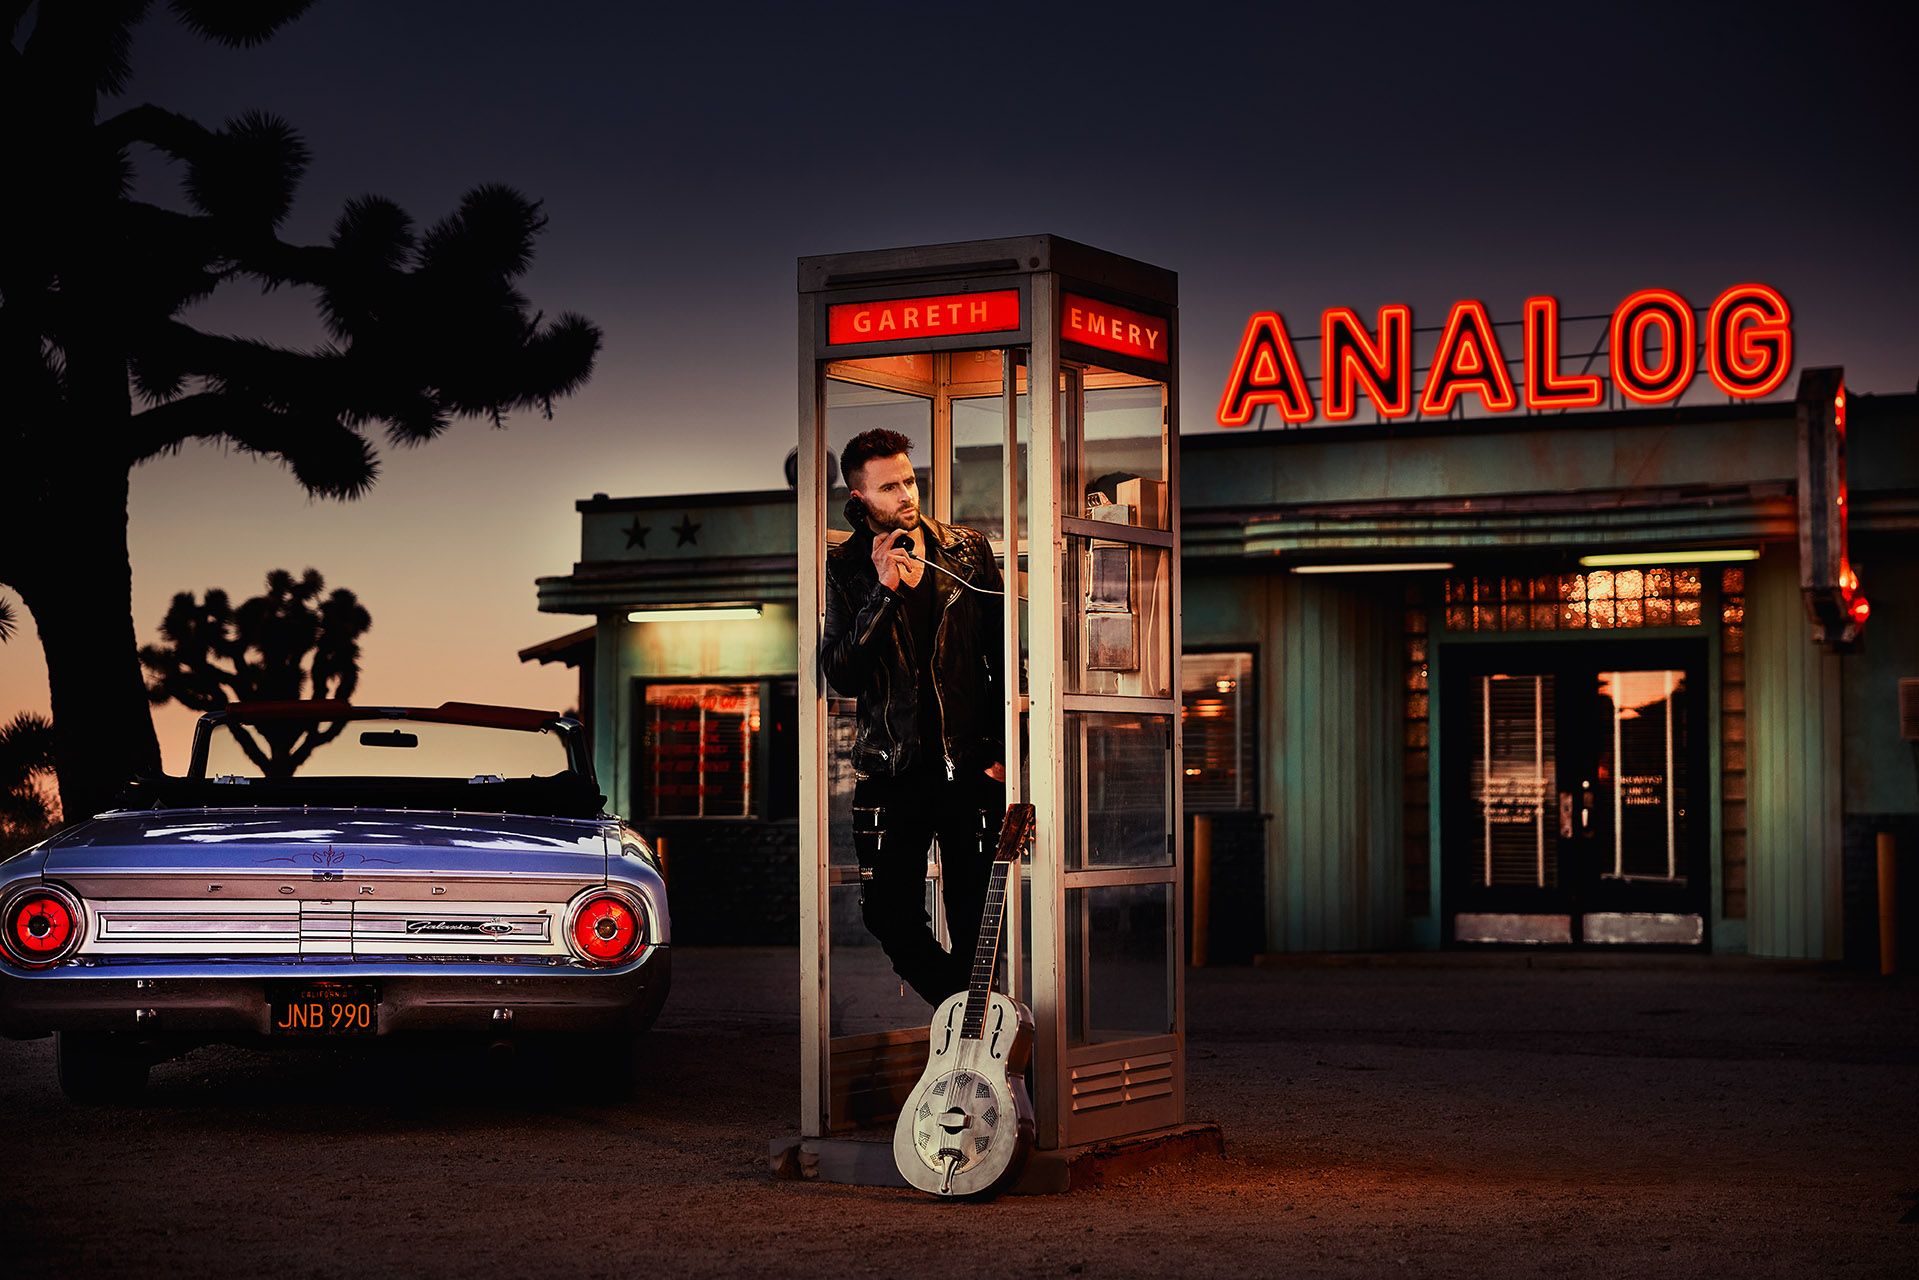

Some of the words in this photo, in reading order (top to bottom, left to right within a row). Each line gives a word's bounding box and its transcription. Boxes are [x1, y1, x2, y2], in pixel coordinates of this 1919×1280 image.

[853, 301, 988, 332] GARETH
[1071, 308, 1159, 350] EMERY
[1217, 283, 1793, 426] ANALOG
[207, 884, 447, 895] FORD
[408, 921, 472, 934] Galaxie
[278, 1003, 323, 1028] JNB
[331, 1003, 370, 1028] 990
